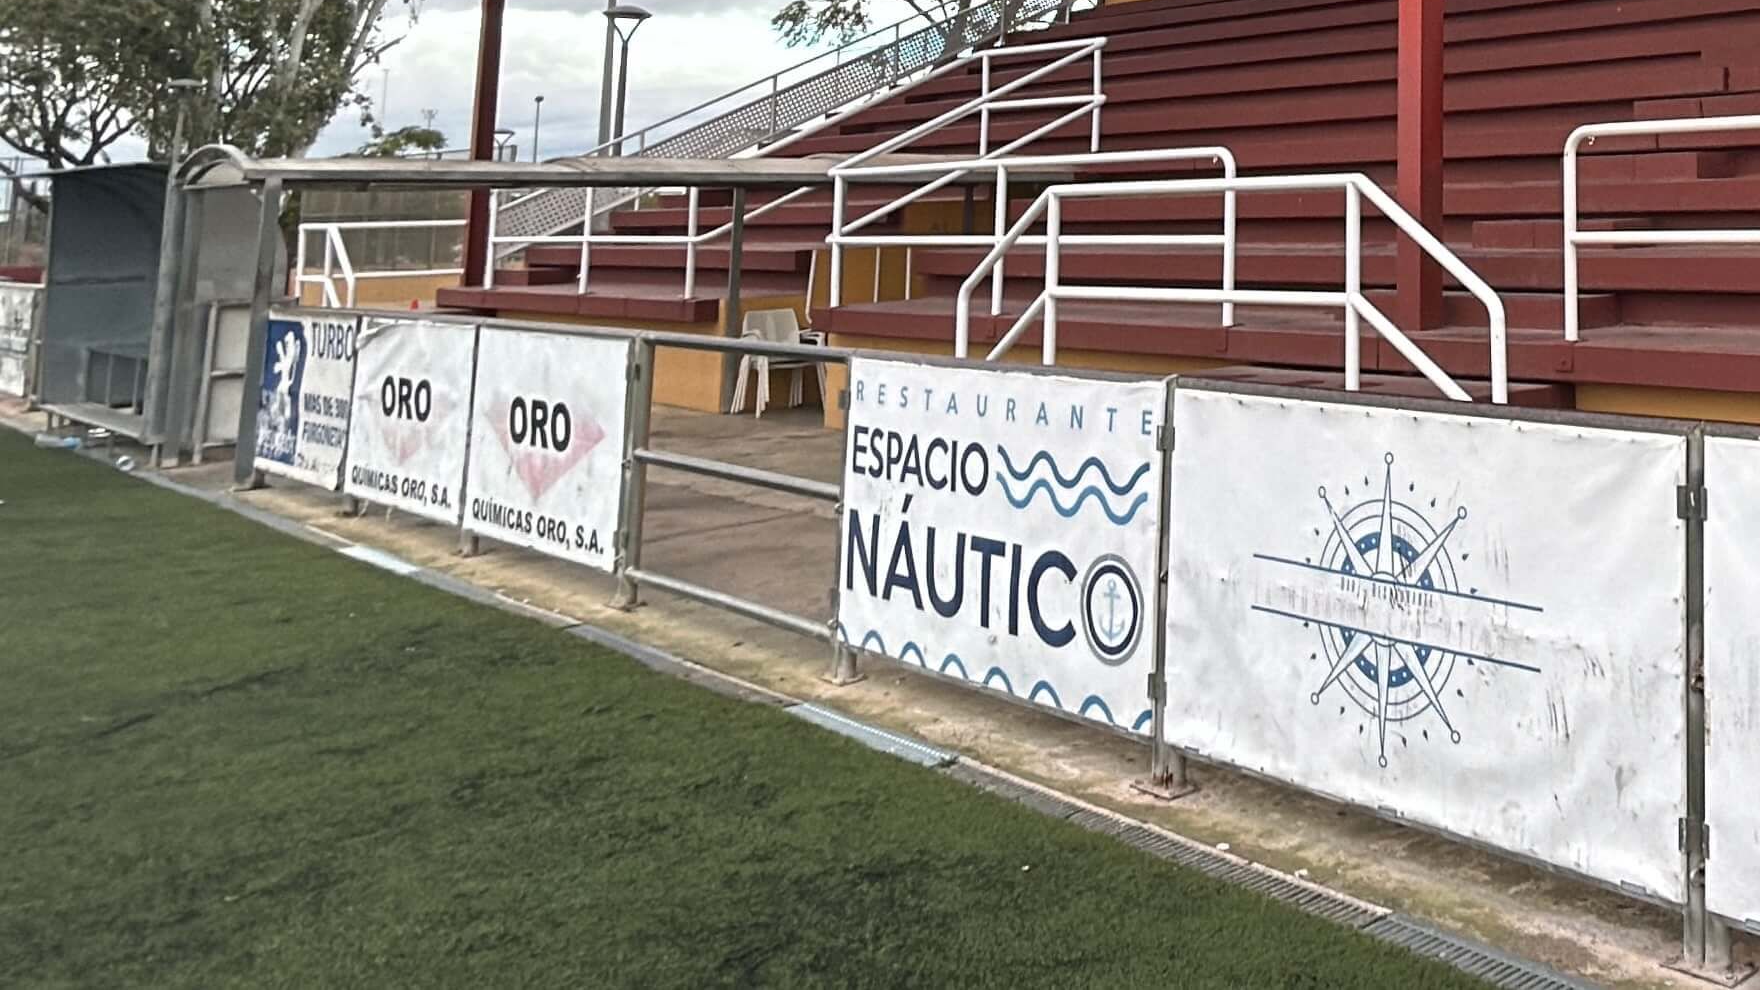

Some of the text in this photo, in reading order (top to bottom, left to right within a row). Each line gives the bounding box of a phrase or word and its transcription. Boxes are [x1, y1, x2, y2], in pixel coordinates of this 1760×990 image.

[311, 322, 355, 362] TURBO
[381, 375, 432, 422] ORO
[509, 396, 572, 452] ORO
[856, 380, 1153, 435] RESTAURANTE
[352, 465, 452, 509] QUÍMICAS ORO, S.A.
[851, 425, 989, 497] ESPACIO
[472, 497, 604, 555] QUÍMICAS ORO, S.A.
